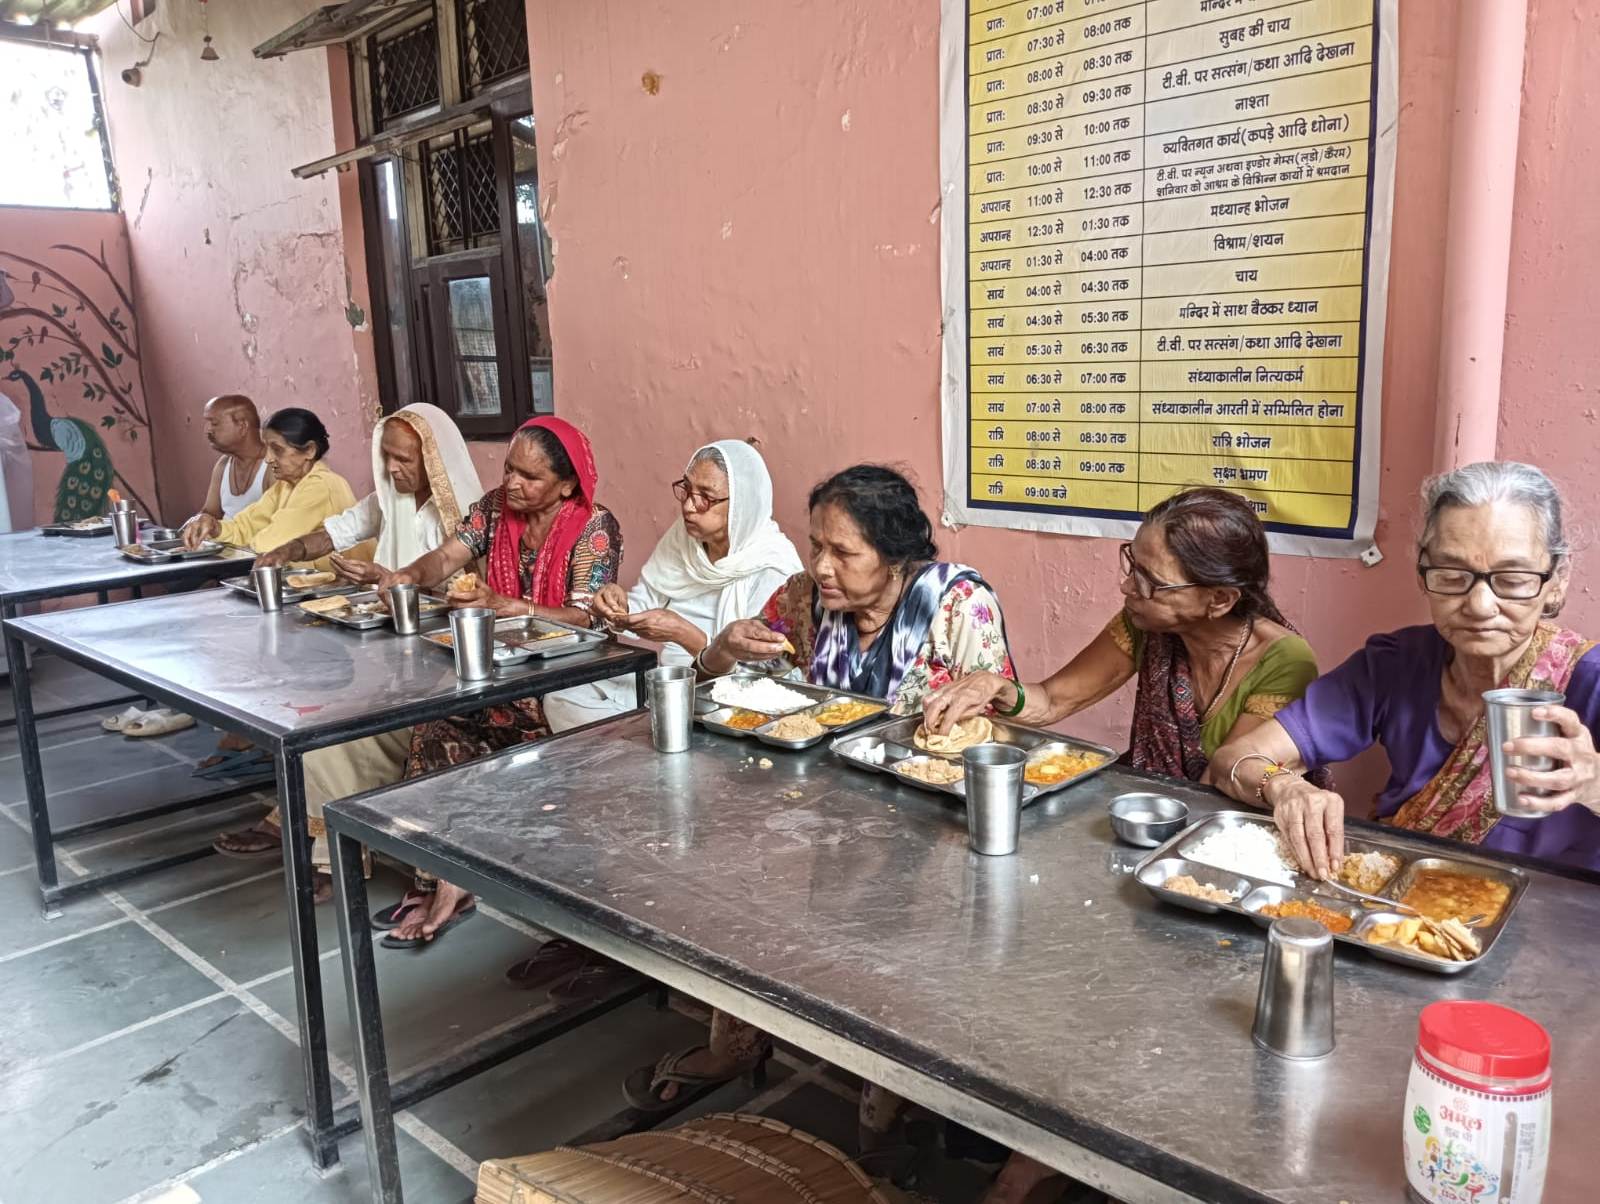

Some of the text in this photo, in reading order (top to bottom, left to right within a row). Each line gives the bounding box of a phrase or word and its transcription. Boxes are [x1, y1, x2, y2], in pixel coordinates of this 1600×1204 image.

[1027, 6, 1053, 20] 07:00
[1028, 37, 1054, 51] 07:30
[1056, 29, 1064, 45] से
[1083, 23, 1111, 38] 08:00
[1113, 17, 1132, 30] तक
[1219, 18, 1291, 48] सुबह की चाय
[1027, 69, 1053, 83] 08:00
[1055, 62, 1063, 77] से
[1083, 56, 1112, 71] 08:30
[1114, 51, 1133, 64] तक
[1162, 69, 1191, 89] टी.वी.
[1195, 69, 1208, 82] पर
[1283, 46, 1312, 66] आदि
[1316, 42, 1355, 61] देखना
[1027, 100, 1053, 114] 08:30
[1055, 94, 1064, 108] से
[1083, 89, 1111, 103] 09:30
[1114, 84, 1132, 97] तक
[1235, 94, 1269, 111] नाश्ता
[1027, 131, 1052, 146] 09:30
[1055, 125, 1063, 140] से
[1084, 123, 1110, 136] 10:00
[1113, 118, 1130, 130] तक
[1278, 118, 1307, 138] आदि
[1027, 163, 1051, 176] 10:00
[1054, 157, 1062, 172] से
[1084, 154, 1111, 167] 11:00
[1113, 150, 1131, 162] तक
[1182, 168, 1192, 178] पर
[1218, 159, 1243, 173] अथवा
[1156, 180, 1188, 197] शनिवार
[1190, 179, 1201, 192] को
[1204, 174, 1228, 190] आश्रम
[1231, 172, 1241, 186] के
[1242, 167, 1276, 184] विभिन्न
[1316, 164, 1350, 177] श्रमदान
[1028, 194, 1052, 207] 11:00
[1055, 188, 1064, 203] से
[1084, 186, 1111, 200] 12:30
[1114, 183, 1132, 195] तक
[1254, 196, 1290, 212] भोजन
[1028, 224, 1053, 237] 12:30
[1055, 219, 1064, 234] से
[1082, 218, 1110, 231] 01:30
[1113, 215, 1130, 227] तक
[1214, 233, 1284, 251] विश्राम/शयन
[1026, 255, 1052, 267] 01:30
[1054, 249, 1063, 264] से
[1081, 250, 1108, 262] 04:00
[1111, 247, 1129, 259] तक
[1236, 270, 1258, 282] चाय
[1026, 286, 1051, 297] 04:00
[1054, 280, 1062, 295] से
[1081, 281, 1109, 293] 04:30
[1112, 279, 1129, 291] तक
[1026, 315, 1051, 326] 04:30
[1054, 310, 1063, 325] से
[1081, 312, 1109, 323] 05:30
[1112, 311, 1129, 321] तक
[1179, 299, 1318, 319] मन्दिर में साथ बैठकर ध्यान
[1026, 345, 1051, 355] 05:30
[1054, 340, 1062, 355] से
[1081, 343, 1108, 353] 06:30
[1111, 342, 1128, 353] तक
[1157, 336, 1185, 351] टी.वी.
[1188, 339, 1201, 350] पर
[1274, 331, 1302, 348] आदि
[1306, 331, 1342, 348] देखना
[1026, 374, 1051, 385] 06:30
[1054, 370, 1062, 384] से
[1081, 373, 1107, 384] 07:00
[1110, 372, 1126, 383] तक
[1188, 365, 1304, 383] संध्याकालीन नित्यकर्म
[1026, 403, 1050, 413] 07:00
[1052, 399, 1061, 413] से
[1081, 403, 1107, 414] 08:00
[1109, 403, 1126, 414] तक
[1152, 399, 1344, 419] संध्याकालीन आरती में सम्मिलित होना
[988, 427, 1126, 443] रात्रि 08:00 से 08:30 तक
[1212, 432, 1271, 449] रात्रि भोजन
[988, 454, 1125, 473] रात्रि 08:30 से 09:00 तक
[988, 481, 1067, 500] रात्रि 09:00 बजे
